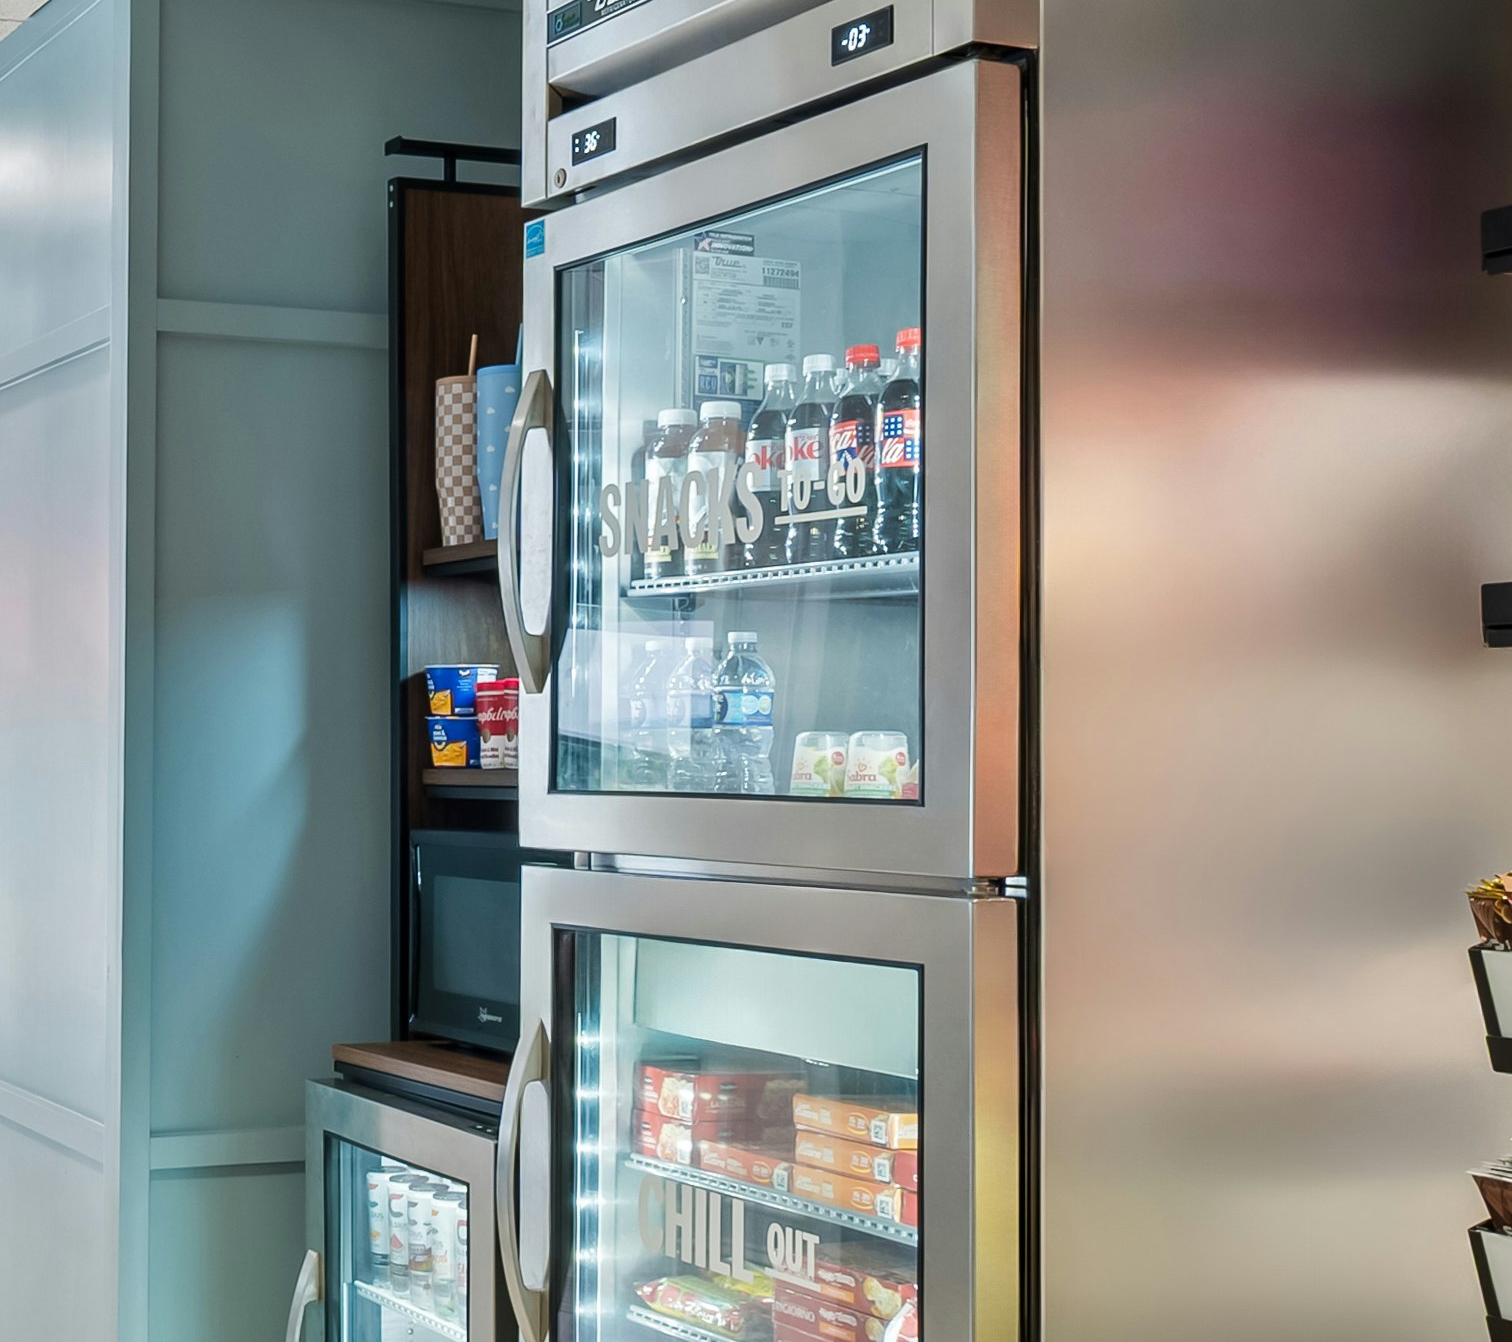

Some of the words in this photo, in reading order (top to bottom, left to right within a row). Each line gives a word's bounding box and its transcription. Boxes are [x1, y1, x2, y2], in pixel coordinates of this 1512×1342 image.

[600, 462, 764, 557] SNACKS
[777, 458, 866, 512] TO-GO
[639, 1173, 754, 1284] CHILL
[767, 1222, 820, 1285] OUT
